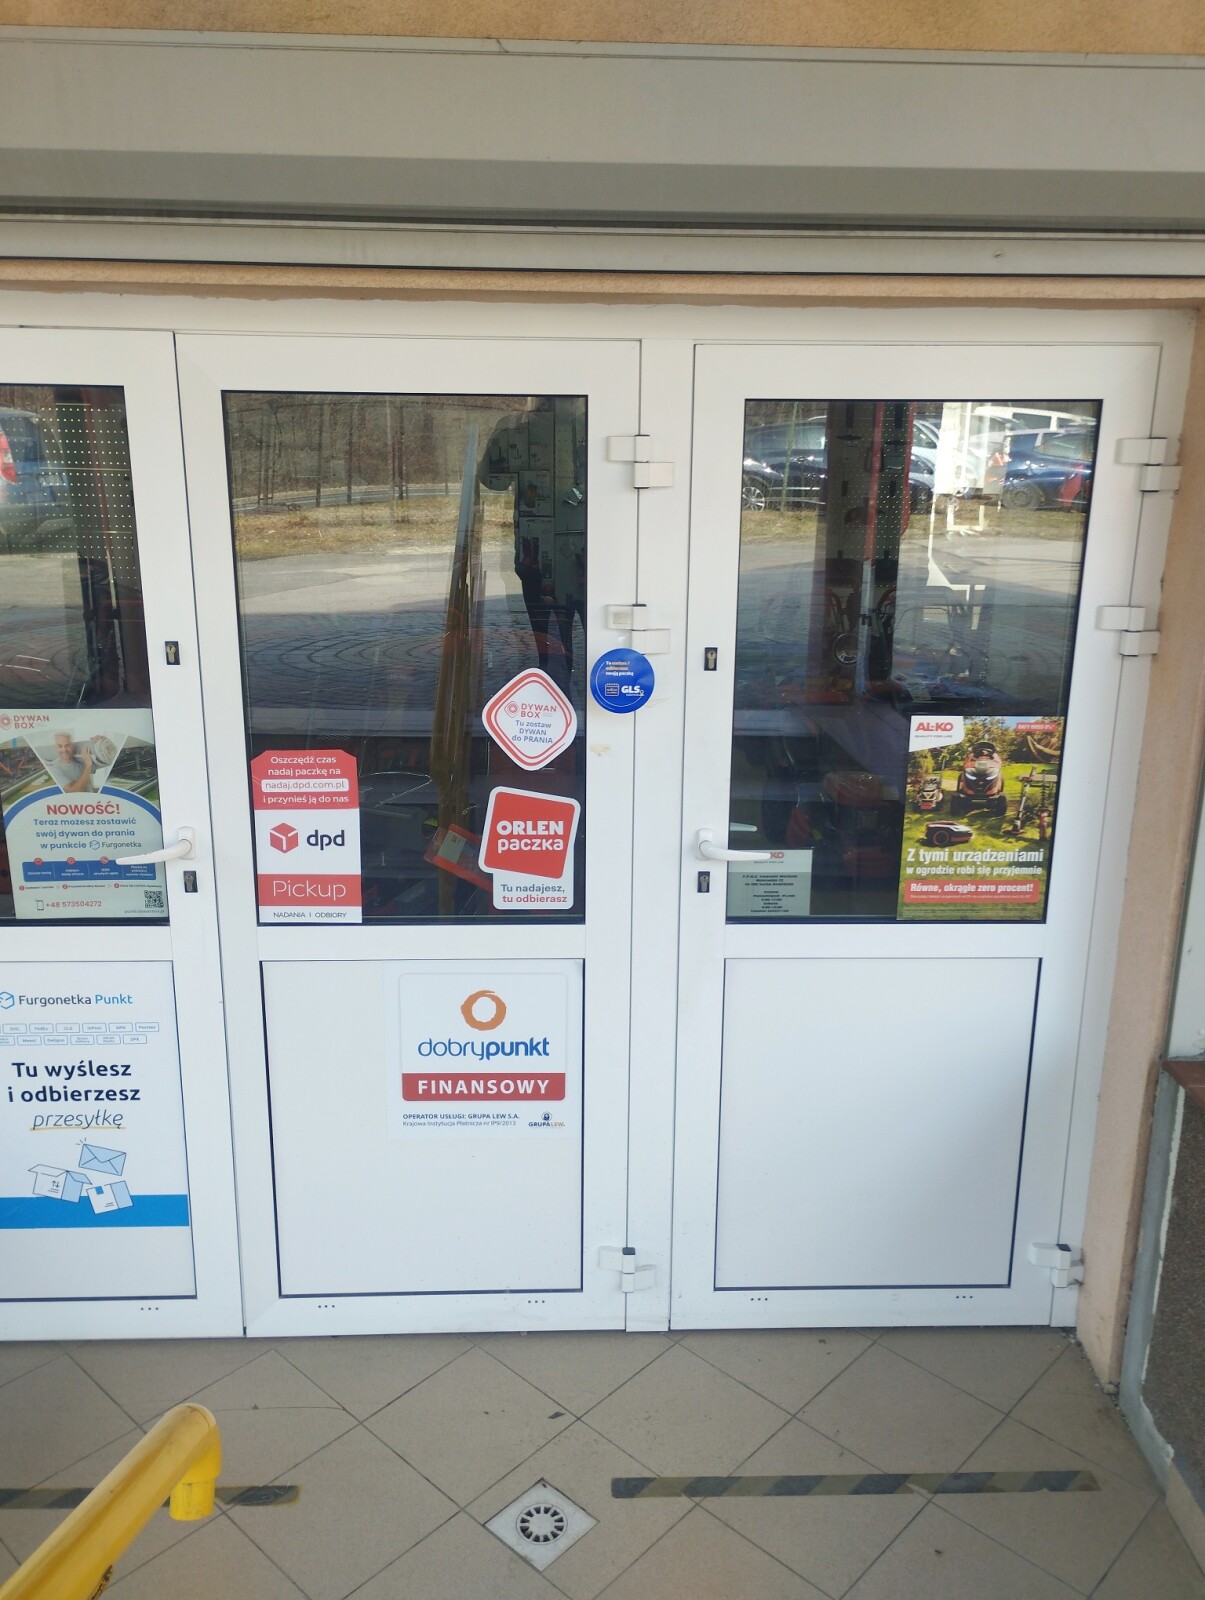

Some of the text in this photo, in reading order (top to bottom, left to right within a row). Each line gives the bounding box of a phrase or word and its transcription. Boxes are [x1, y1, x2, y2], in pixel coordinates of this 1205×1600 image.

[621, 685, 640, 694] GLS
[521, 703, 557, 712] DYWAN
[915, 722, 954, 731] AL-KO
[271, 755, 314, 764] Oszczędź
[268, 768, 293, 776] nadaj
[295, 768, 327, 776] paczkę
[265, 780, 345, 790] nadaj.dpd.com.pl
[268, 795, 307, 804] przynieś
[309, 795, 317, 804] ją
[47, 801, 120, 815] NOWOŚĆ!
[61, 817, 94, 826] możesz
[96, 817, 136, 825] zostawić
[496, 820, 564, 836] ORLEN
[36, 829, 135, 838] swój dywan do prania
[306, 830, 345, 850] dpd
[50, 841, 87, 850] punkcie
[102, 841, 141, 850] Furgonetka
[498, 838, 564, 853] paczka
[907, 848, 1044, 864] Z tymi urządzeniami
[916, 866, 955, 876] ogrodzie
[957, 866, 974, 874] robi
[977, 866, 990, 876] się
[993, 866, 1042, 876] przyjemnie
[273, 880, 346, 901] Pickup
[501, 884, 565, 895] Tu nadajesz,
[910, 883, 1034, 893] Równe, okrągłe zero procent!
[516, 894, 567, 903] odbierasz
[19, 993, 133, 1007] Furgonetka Punkt
[418, 1037, 549, 1060] dobrypunkt
[12, 1060, 132, 1080] Tu wyślesz
[418, 1080, 549, 1094] FINANSOWY
[8, 1085, 141, 1102] i odbierzesz
[33, 1110, 123, 1130] przesyłkę
